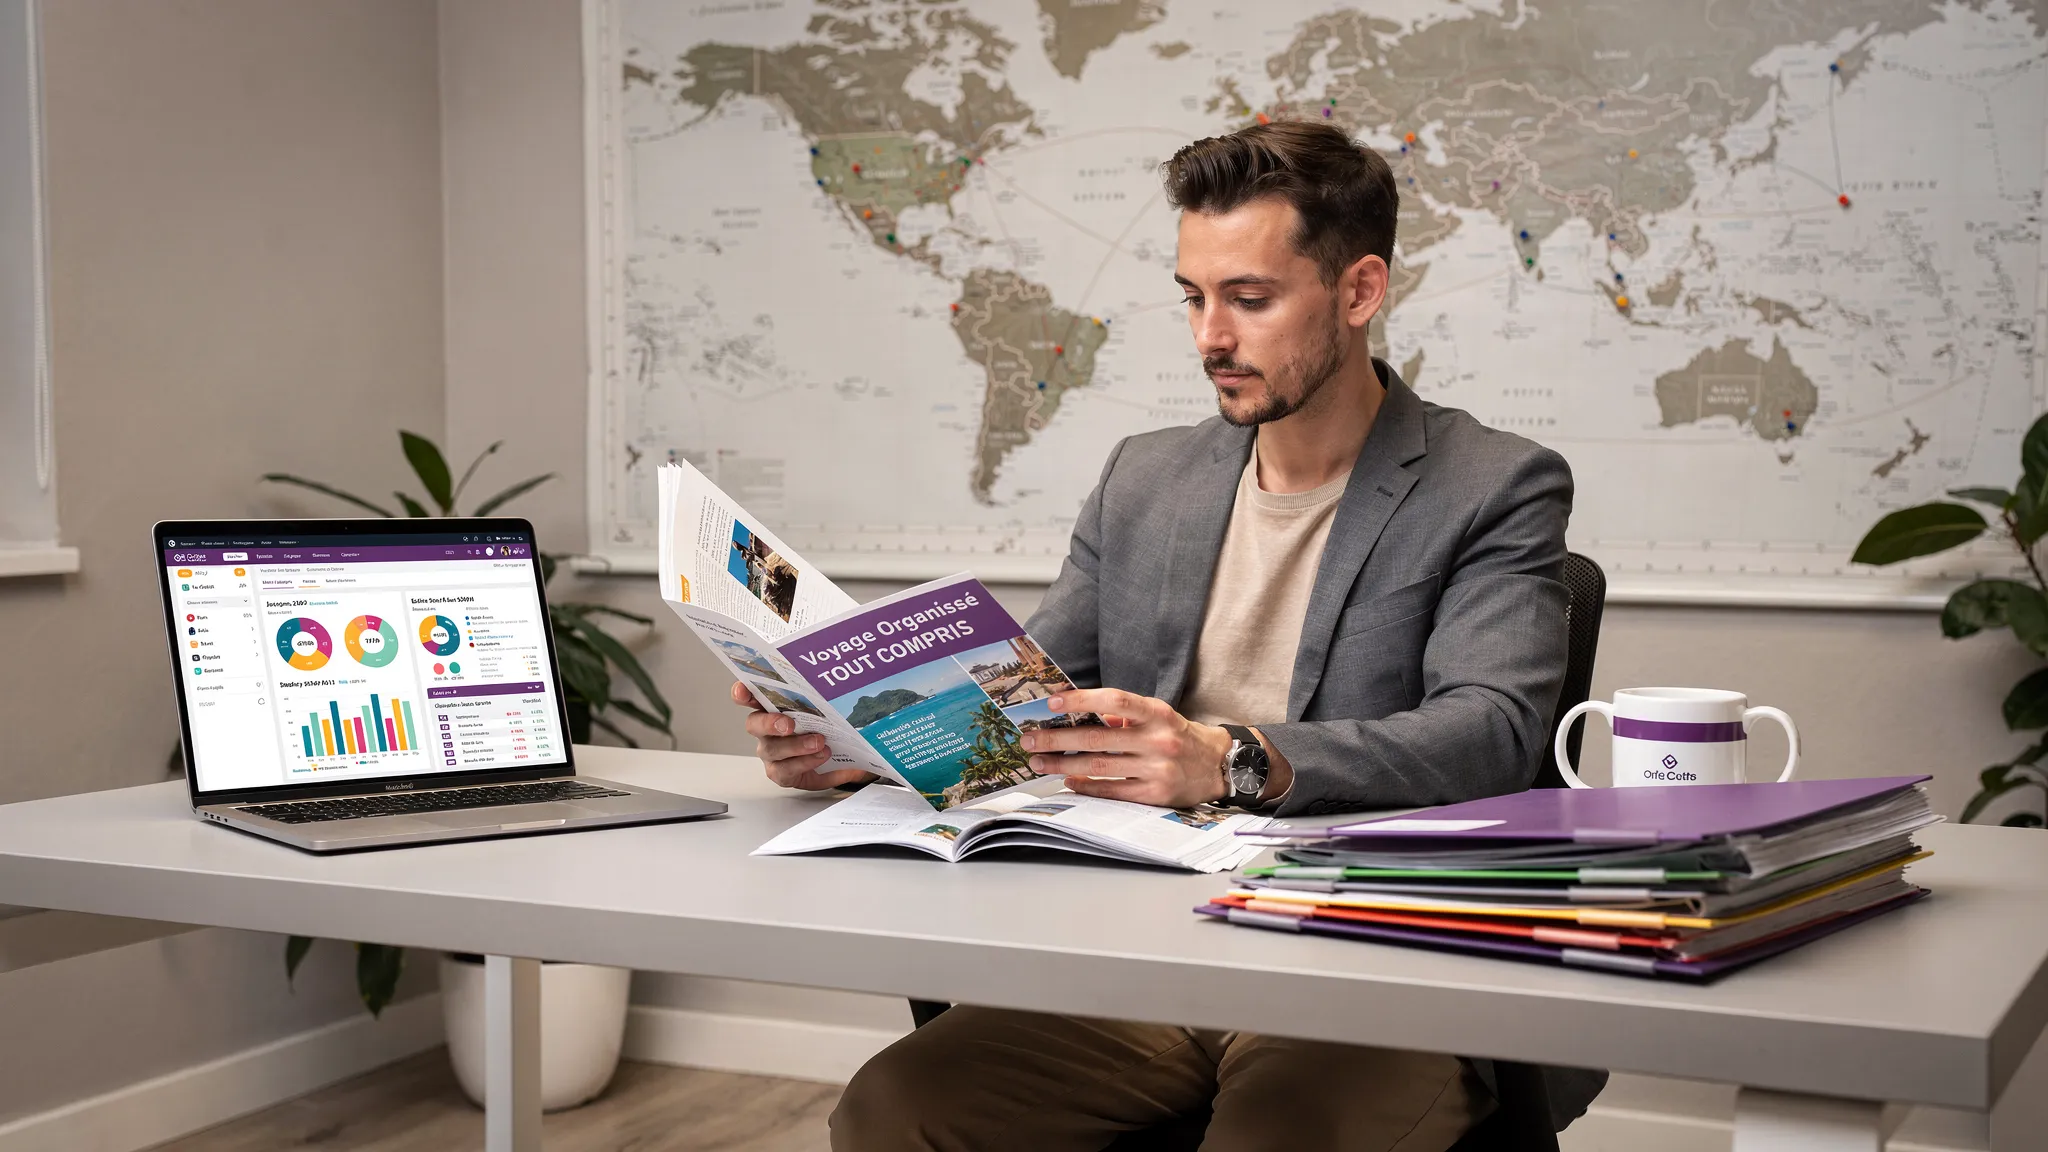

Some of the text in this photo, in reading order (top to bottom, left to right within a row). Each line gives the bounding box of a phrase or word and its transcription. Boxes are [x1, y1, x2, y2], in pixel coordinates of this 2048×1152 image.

[799, 591, 980, 666] Voyage Organissé
[818, 620, 975, 687] TOUT COMPRIS
